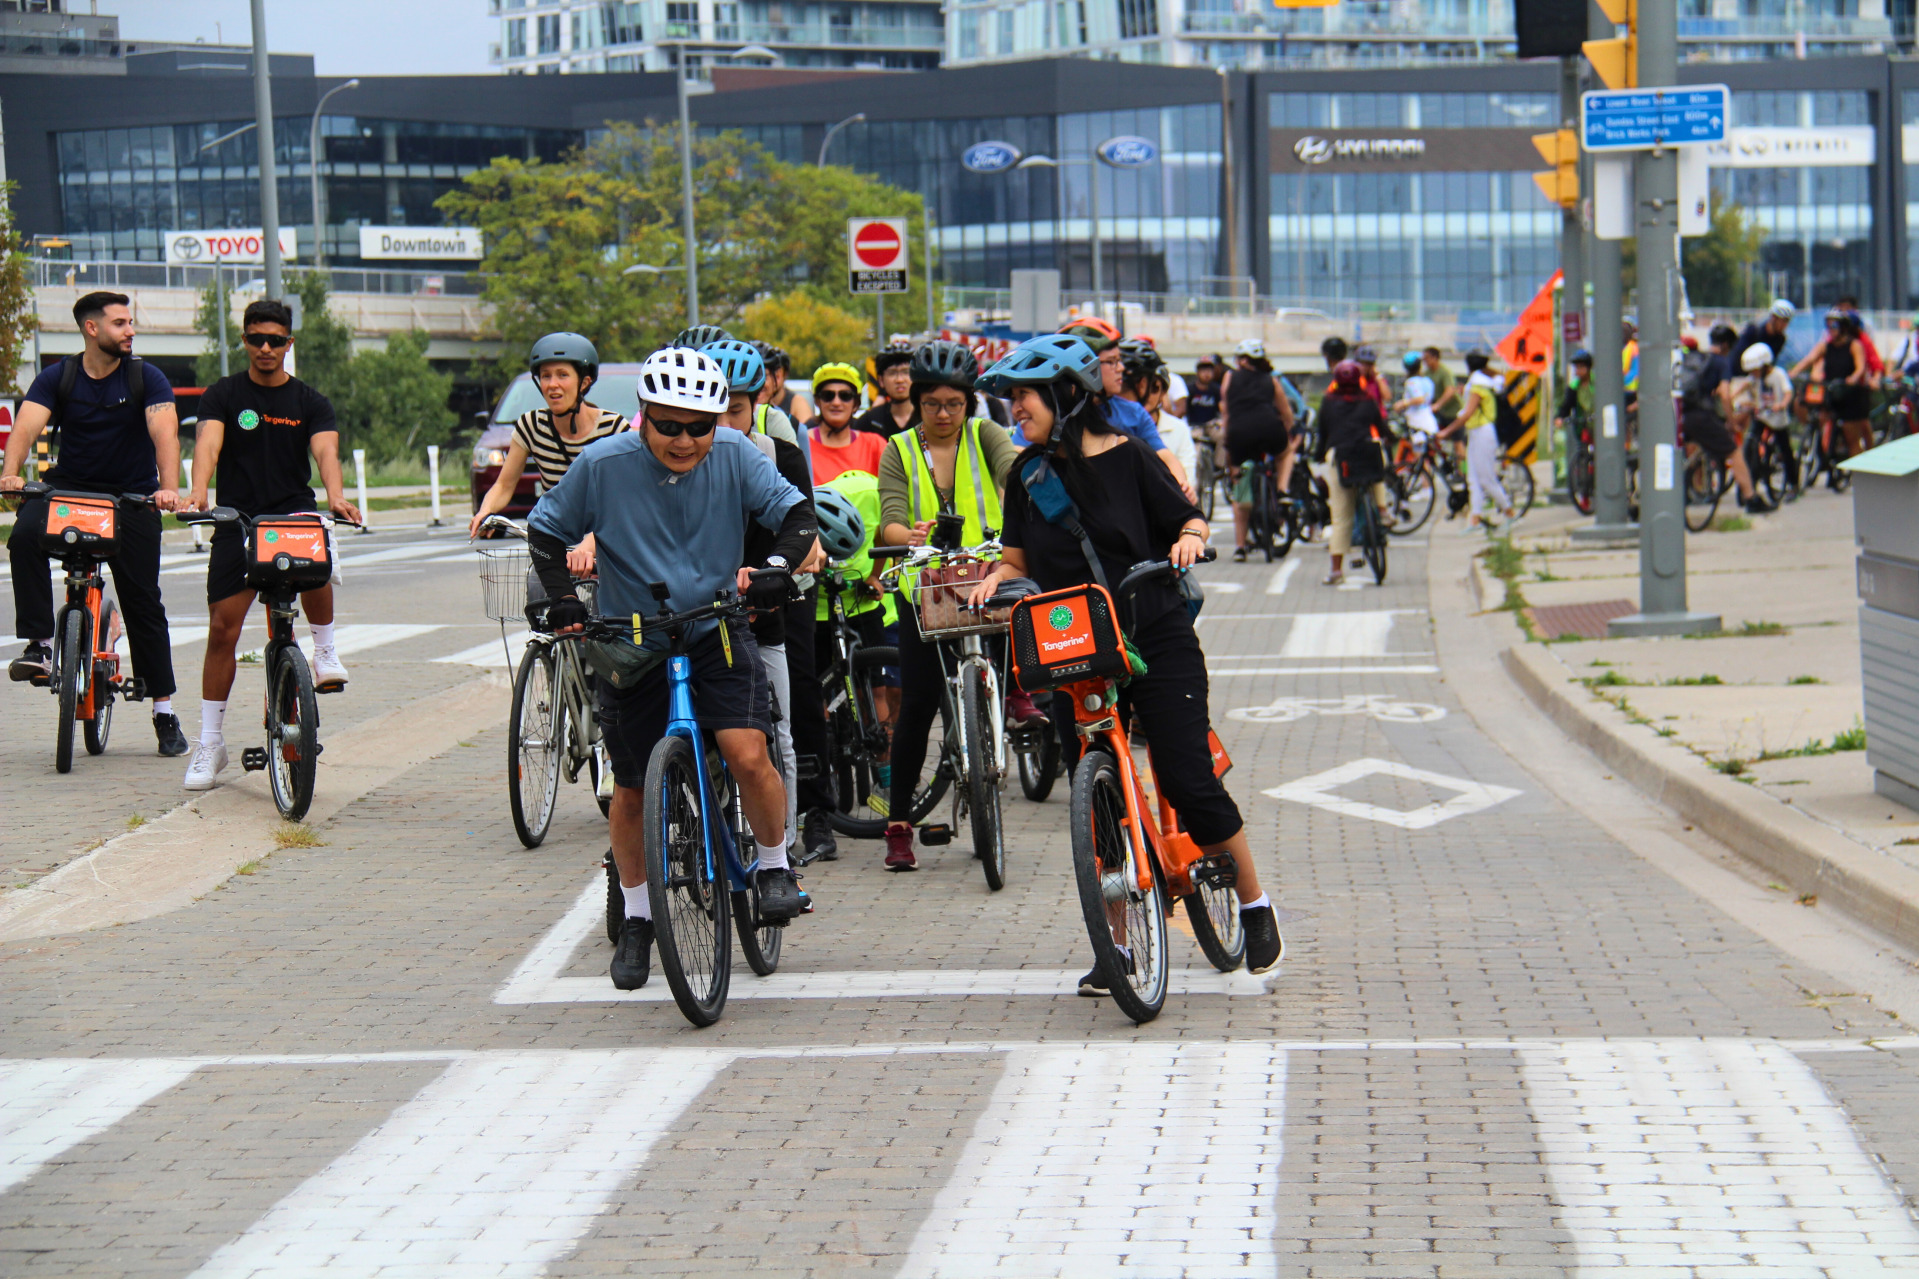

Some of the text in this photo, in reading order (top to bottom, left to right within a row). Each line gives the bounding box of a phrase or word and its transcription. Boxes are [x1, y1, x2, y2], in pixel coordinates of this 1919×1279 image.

[204, 236, 286, 255] TOYO
[381, 235, 466, 253] Downtown
[857, 271, 899, 280] BICYCLES
[857, 281, 900, 290] EXCEPTED
[76, 508, 105, 517] Tangerine
[285, 532, 314, 541] Tangerine
[1041, 636, 1085, 652] Tangerine
